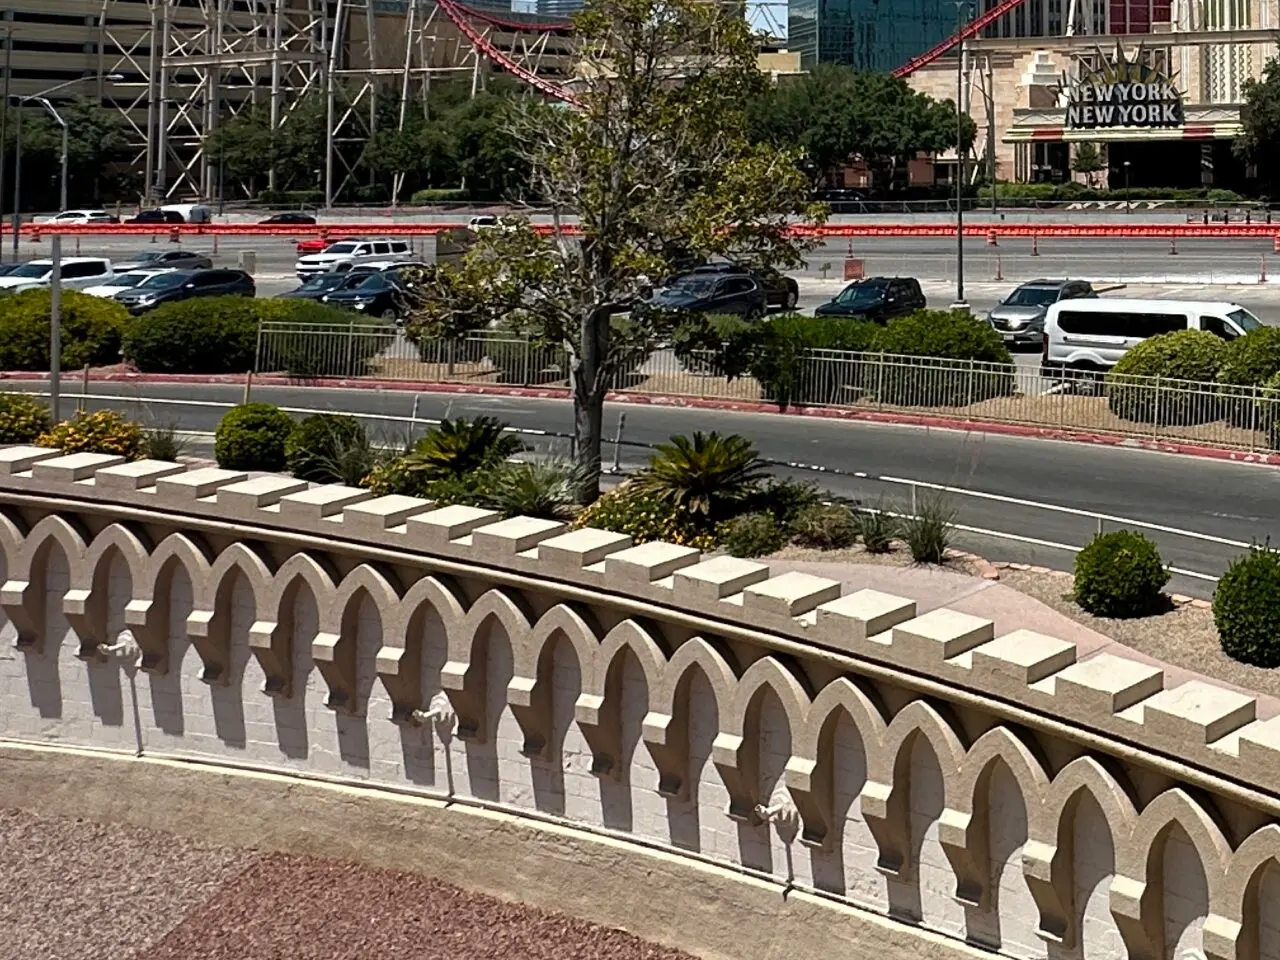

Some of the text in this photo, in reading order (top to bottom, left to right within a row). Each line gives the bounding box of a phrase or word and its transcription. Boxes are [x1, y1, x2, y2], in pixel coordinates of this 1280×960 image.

[1069, 82, 1178, 103] NEW YORK
[1068, 104, 1179, 124] NEW YORK
